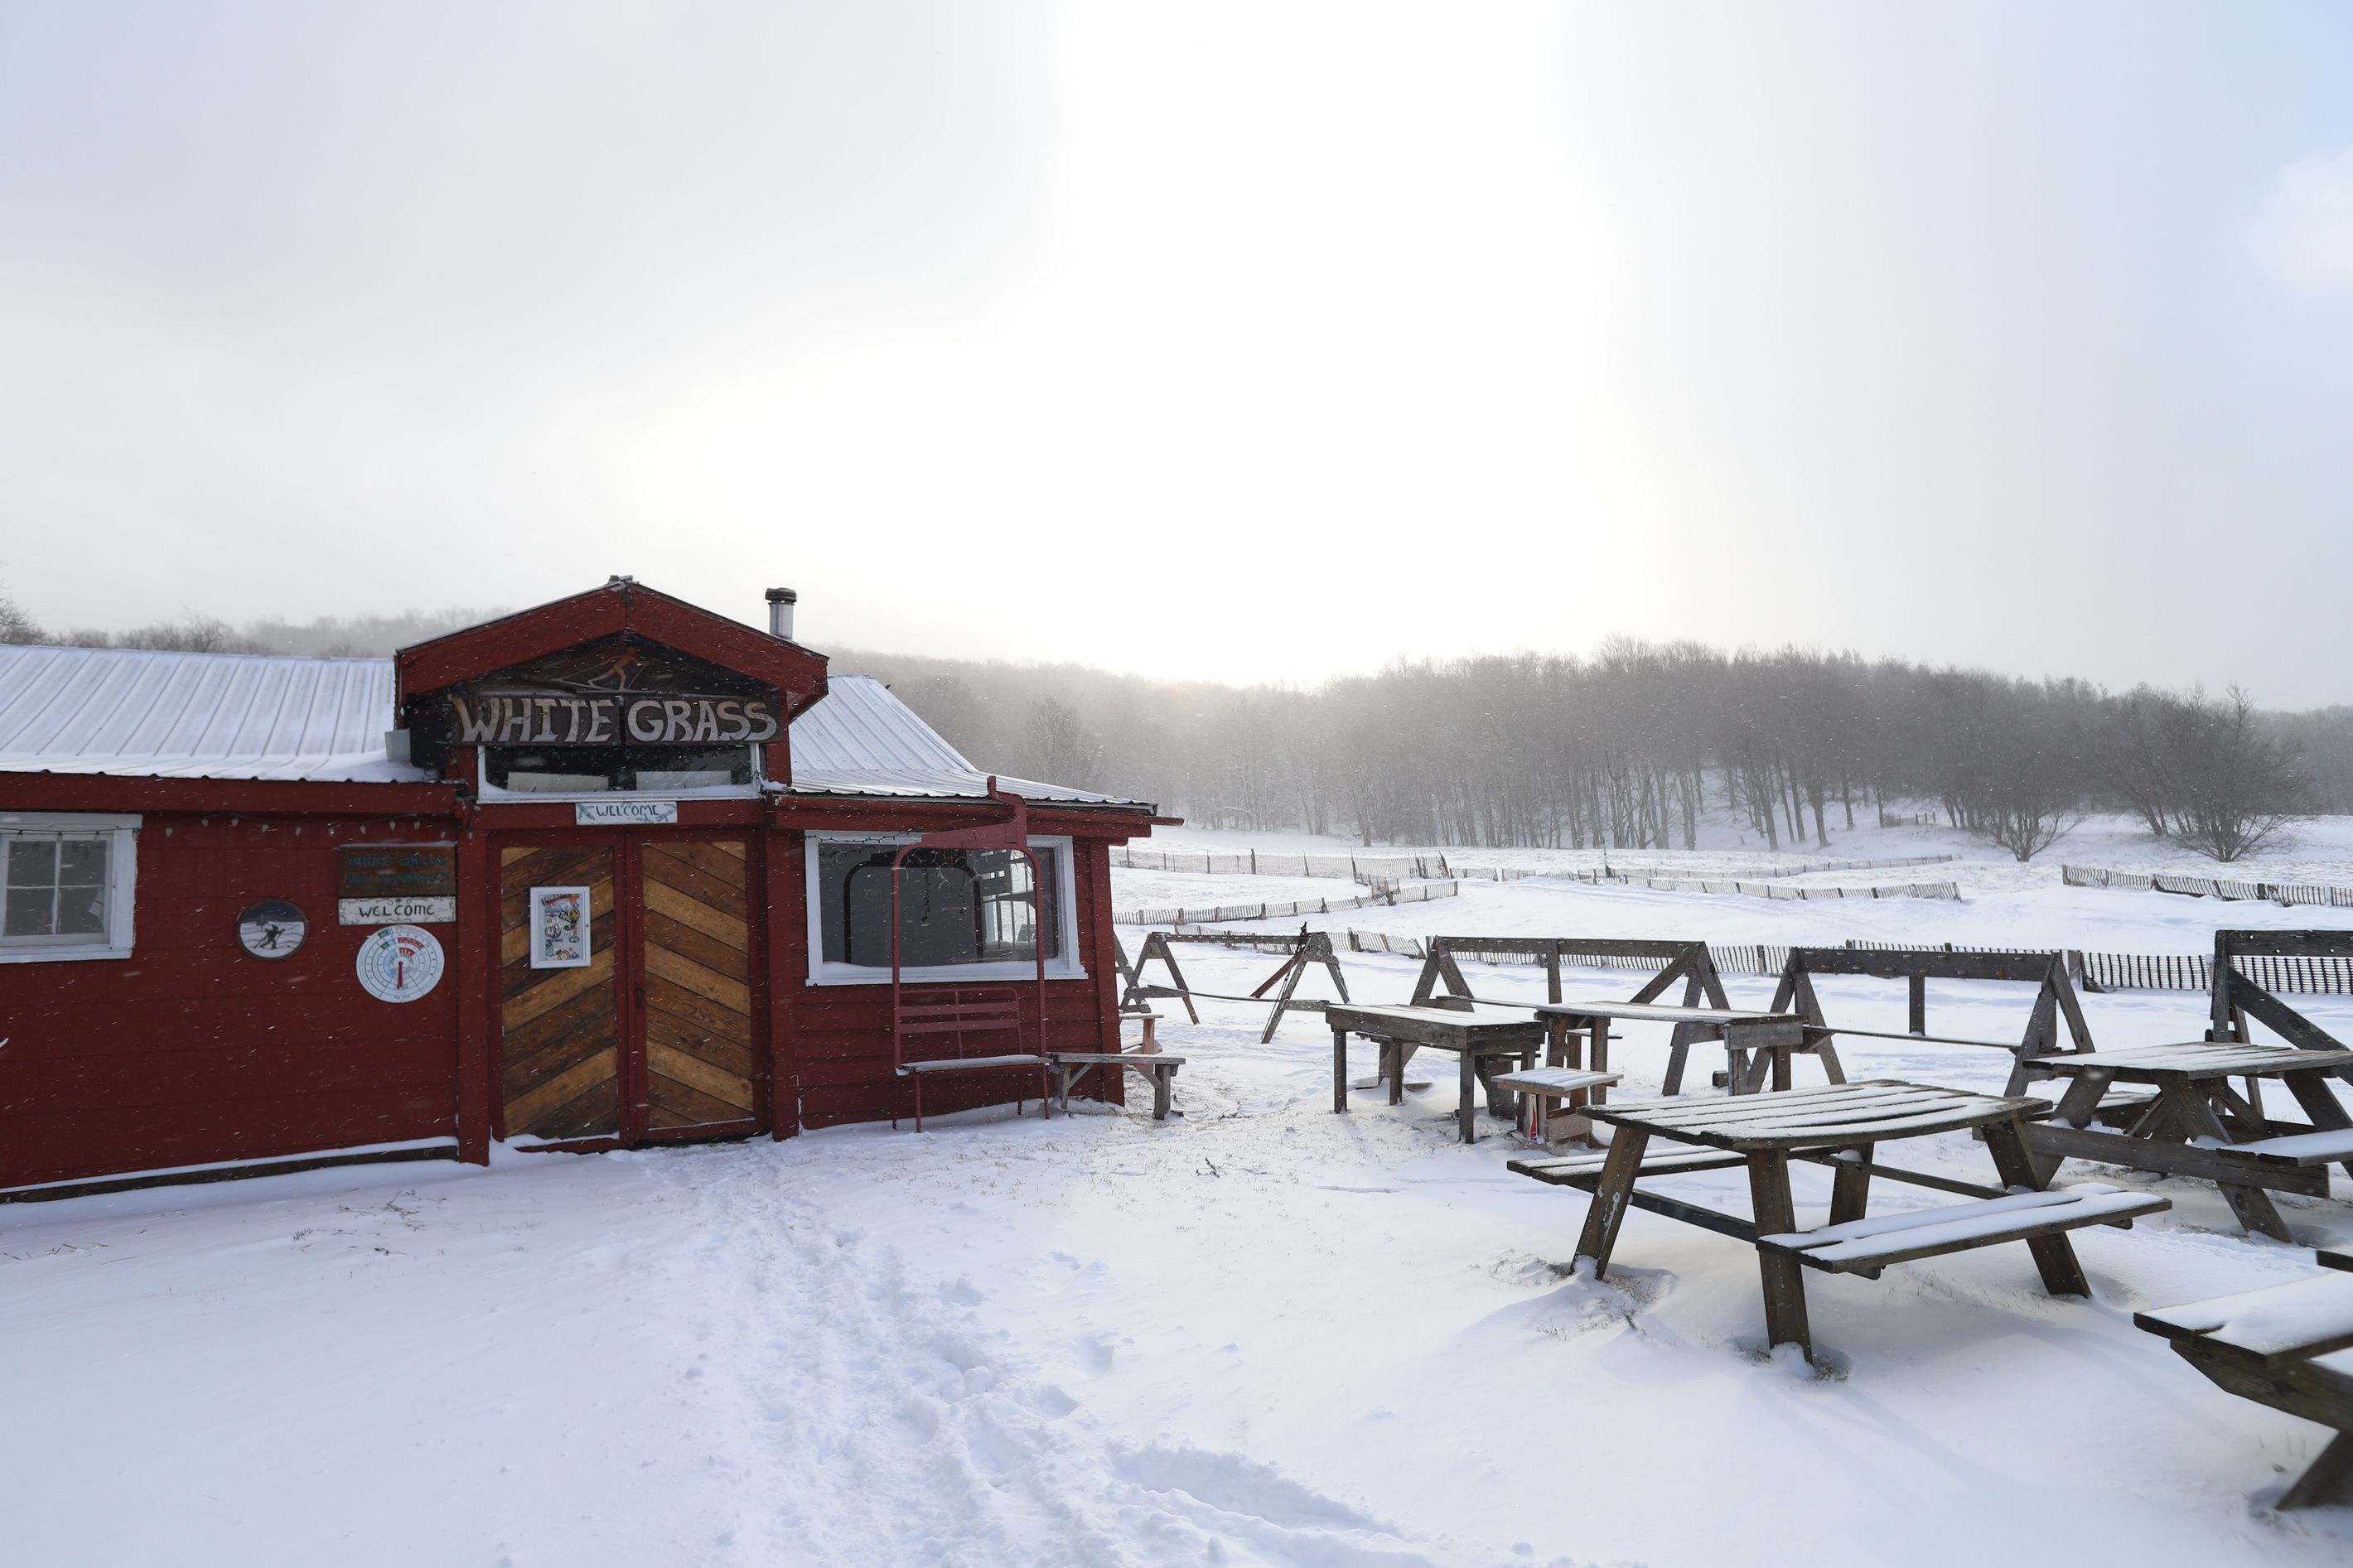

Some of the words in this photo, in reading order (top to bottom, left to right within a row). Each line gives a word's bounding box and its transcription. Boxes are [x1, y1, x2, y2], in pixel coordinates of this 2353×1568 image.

[452, 697, 614, 742] WHITE
[627, 699, 778, 742] GRASS
[596, 804, 660, 818] WELCOME
[359, 903, 435, 918] WELCOME
